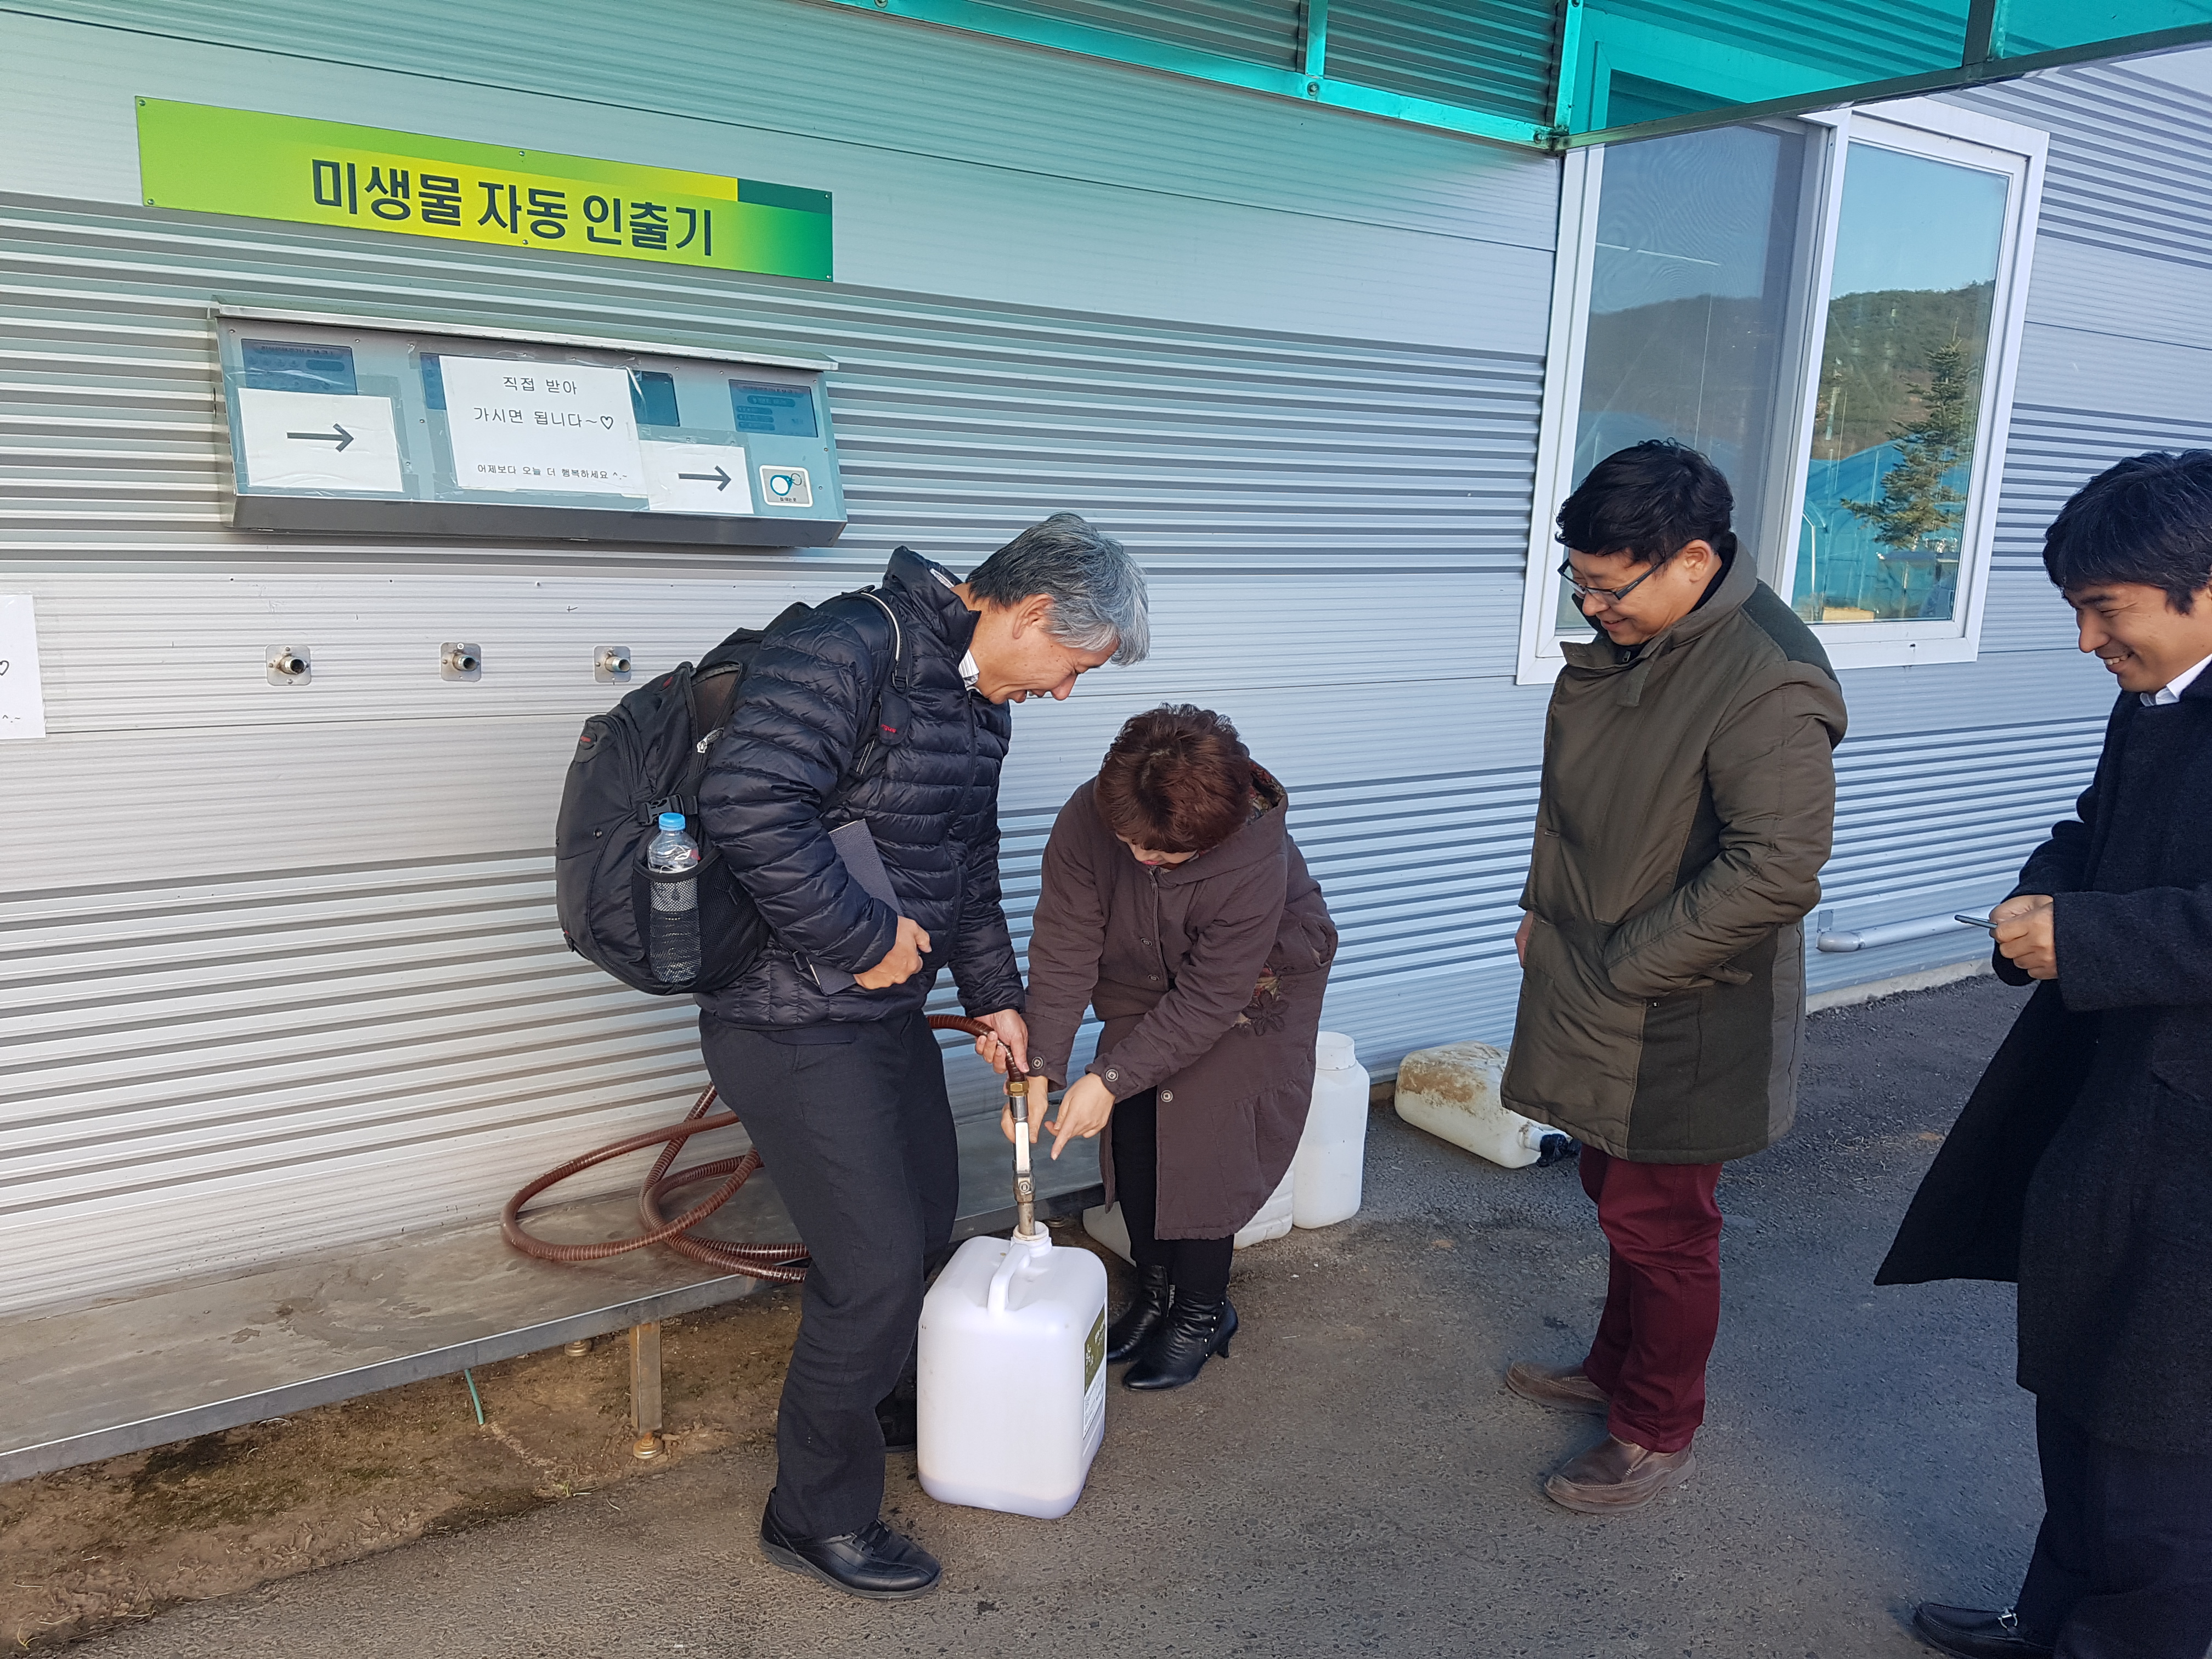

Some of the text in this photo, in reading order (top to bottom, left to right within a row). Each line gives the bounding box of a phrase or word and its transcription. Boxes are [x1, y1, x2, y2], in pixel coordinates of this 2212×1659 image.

[312, 159, 712, 257] 미생물 자동 인출기
[503, 376, 578, 395] 직접 받아
[473, 407, 523, 424] 가시면
[477, 464, 517, 475] 어제보다
[522, 466, 541, 476] 오늘
[546, 467, 556, 476] 더
[561, 469, 609, 479] 행복하세요
